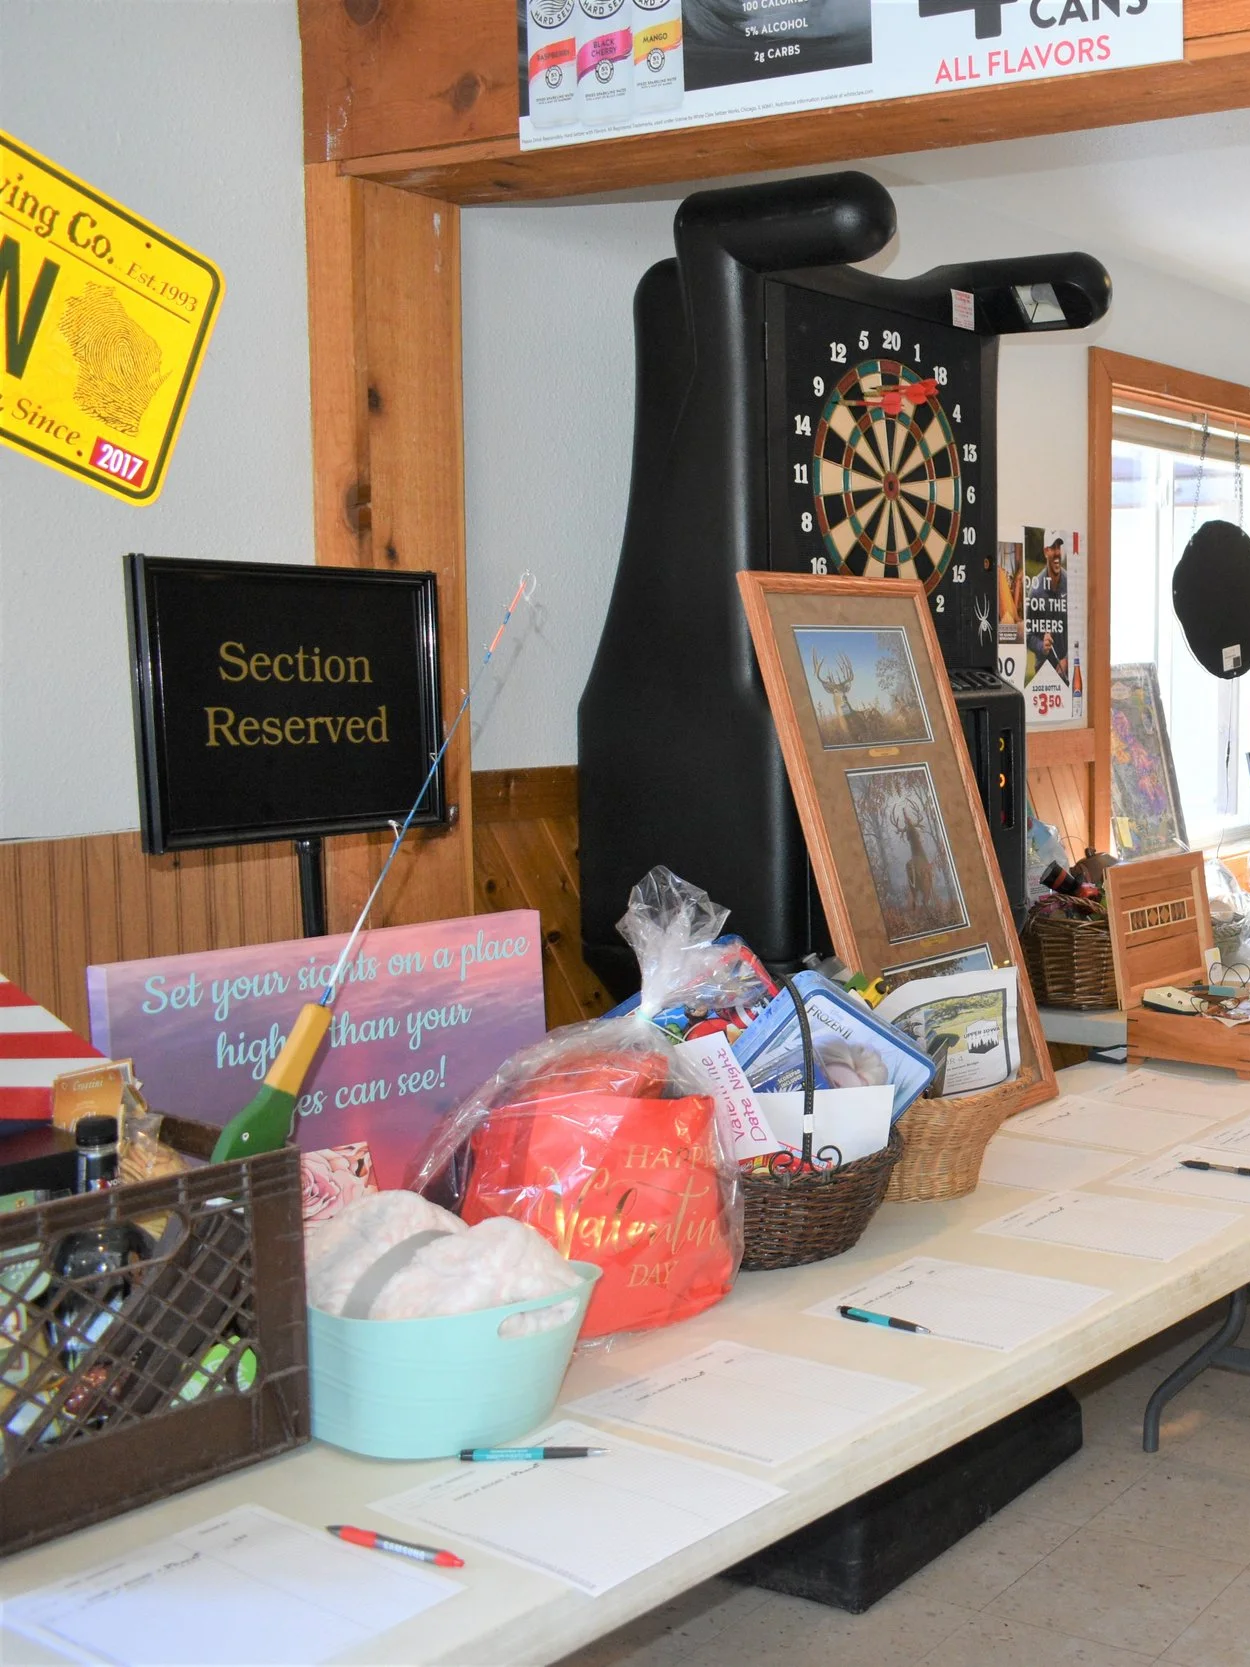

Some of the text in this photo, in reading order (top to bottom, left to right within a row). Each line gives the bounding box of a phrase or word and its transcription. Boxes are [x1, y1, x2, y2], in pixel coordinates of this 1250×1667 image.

[582, 1, 605, 15] HARD
[742, 0, 809, 12] 100 CALO
[534, 11, 555, 25] HARD
[745, 17, 809, 38] 5% ALCOHOL
[592, 38, 615, 48] BLACK
[643, 33, 669, 43] MANGO
[590, 46, 618, 58] CHERRY
[754, 44, 801, 63] 2g CARBS
[934, 35, 1111, 84] ALL FLAVORS
[67, 211, 114, 264] Co.
[858, 330, 870, 350] 5
[882, 330, 902, 351] 20
[830, 342, 847, 363] 12
[914, 344, 921, 362] 1
[933, 366, 948, 385] 18
[813, 376, 825, 397] 9
[11, 397, 82, 447] Since
[952, 404, 961, 423] 4
[794, 415, 811, 436] 14
[97, 443, 144, 481] 2017
[963, 444, 977, 462] 13
[793, 463, 809, 484] 11
[966, 486, 976, 503] 6
[801, 512, 813, 533] 8
[962, 527, 976, 545] 10
[811, 557, 828, 575] 16
[952, 564, 966, 583] 15
[1024, 575, 1052, 590] DO IT
[936, 594, 945, 613] 2
[1024, 597, 1067, 613] FOR THE
[1025, 618, 1064, 634] CHEERS
[218, 640, 373, 684] Section
[203, 704, 391, 747] Reserved
[142, 930, 529, 1023] Set your sights on a place
[806, 1004, 843, 1034] FROZEN
[216, 1001, 473, 1081] high than your
[964, 1030, 982, 1039] UPPER
[717, 1047, 745, 1091] Night
[335, 1079, 392, 1109] can
[397, 1055, 448, 1097] see!
[741, 1097, 768, 1142] Date
[508, 1163, 719, 1262] Valentin
[627, 1259, 681, 1289] DAY
